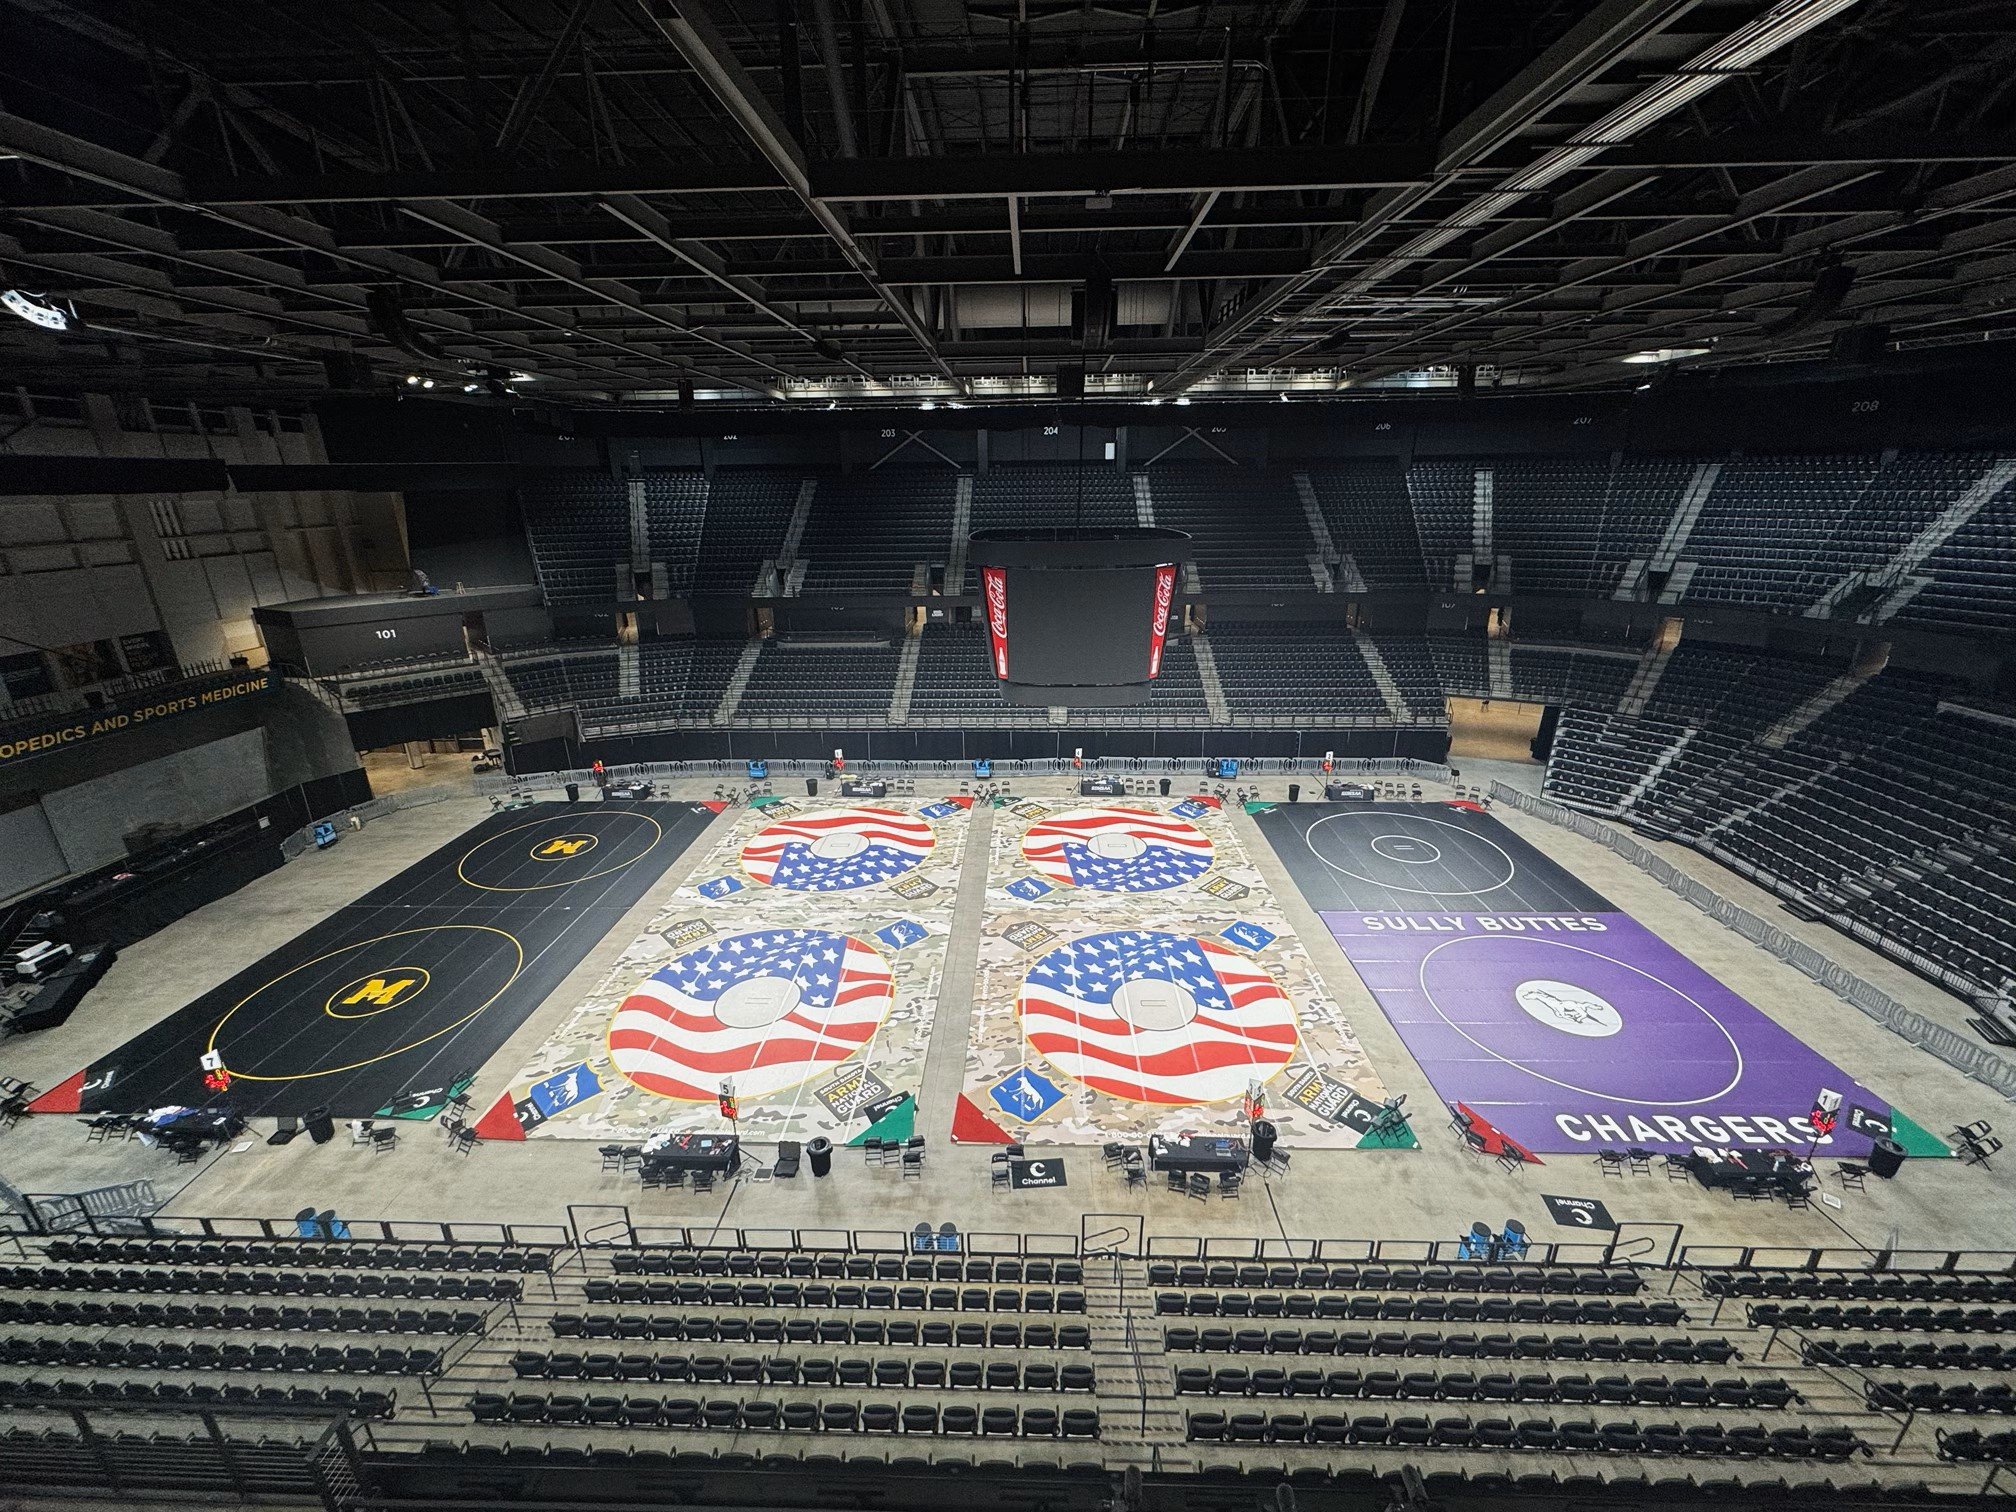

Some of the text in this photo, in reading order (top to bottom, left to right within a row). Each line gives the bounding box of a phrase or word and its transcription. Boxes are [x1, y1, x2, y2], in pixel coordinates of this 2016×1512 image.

[1852, 400, 1880, 412] 208
[880, 428, 896, 438] 203
[1043, 426, 1059, 435] 204
[987, 572, 1008, 639] Coca-Cola
[1153, 571, 1172, 637] Coca-Cola
[375, 629, 397, 640] 101
[0, 677, 269, 759] OPEDICS AND SPORTS MEDICINE
[541, 840, 589, 854] M
[1362, 916, 1608, 932] SULLY BUTTES
[341, 979, 416, 1004] M
[206, 1058, 213, 1067] 7
[723, 1084, 729, 1094] 5
[832, 1081, 876, 1107] NATIOAL
[837, 1085, 882, 1114] GUARD
[1318, 1087, 1349, 1116] GUARD
[1555, 1114, 1834, 1144] CHARGERS
[1029, 1162, 1046, 1177] C
[1022, 1177, 1056, 1185] Channel
[1555, 1198, 1595, 1210] Channel
